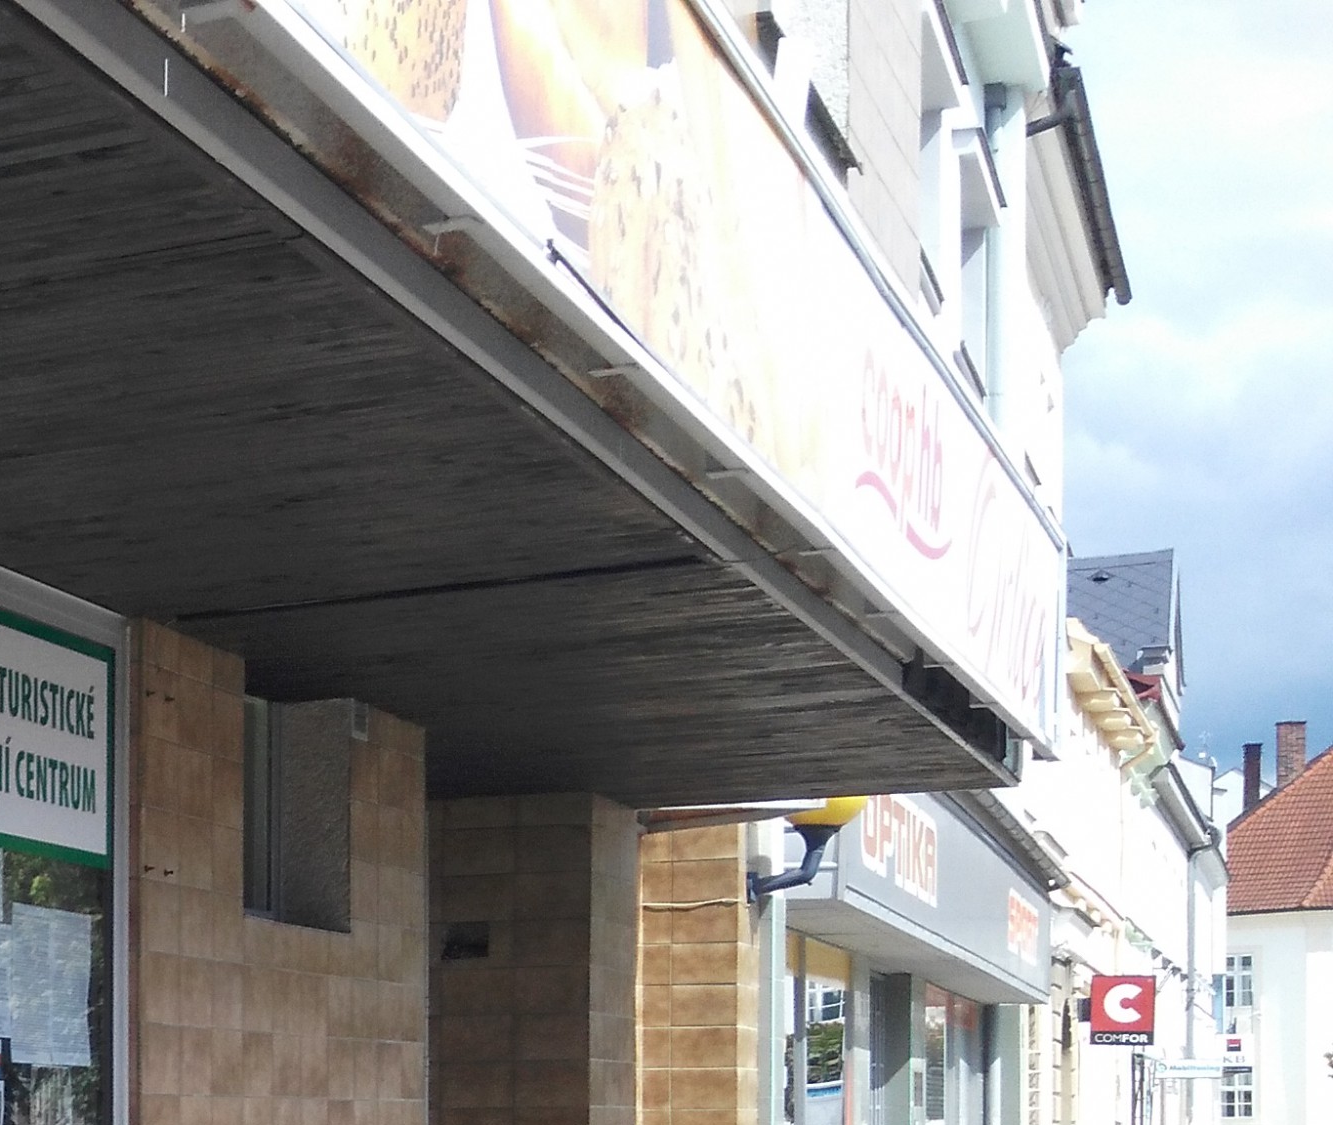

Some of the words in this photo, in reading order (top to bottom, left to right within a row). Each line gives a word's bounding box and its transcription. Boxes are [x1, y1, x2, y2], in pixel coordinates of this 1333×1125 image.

[15, 750, 97, 814] CENTRUM
[862, 796, 937, 907] OPTIKA
[1095, 1034, 1149, 1043] COMFOR
